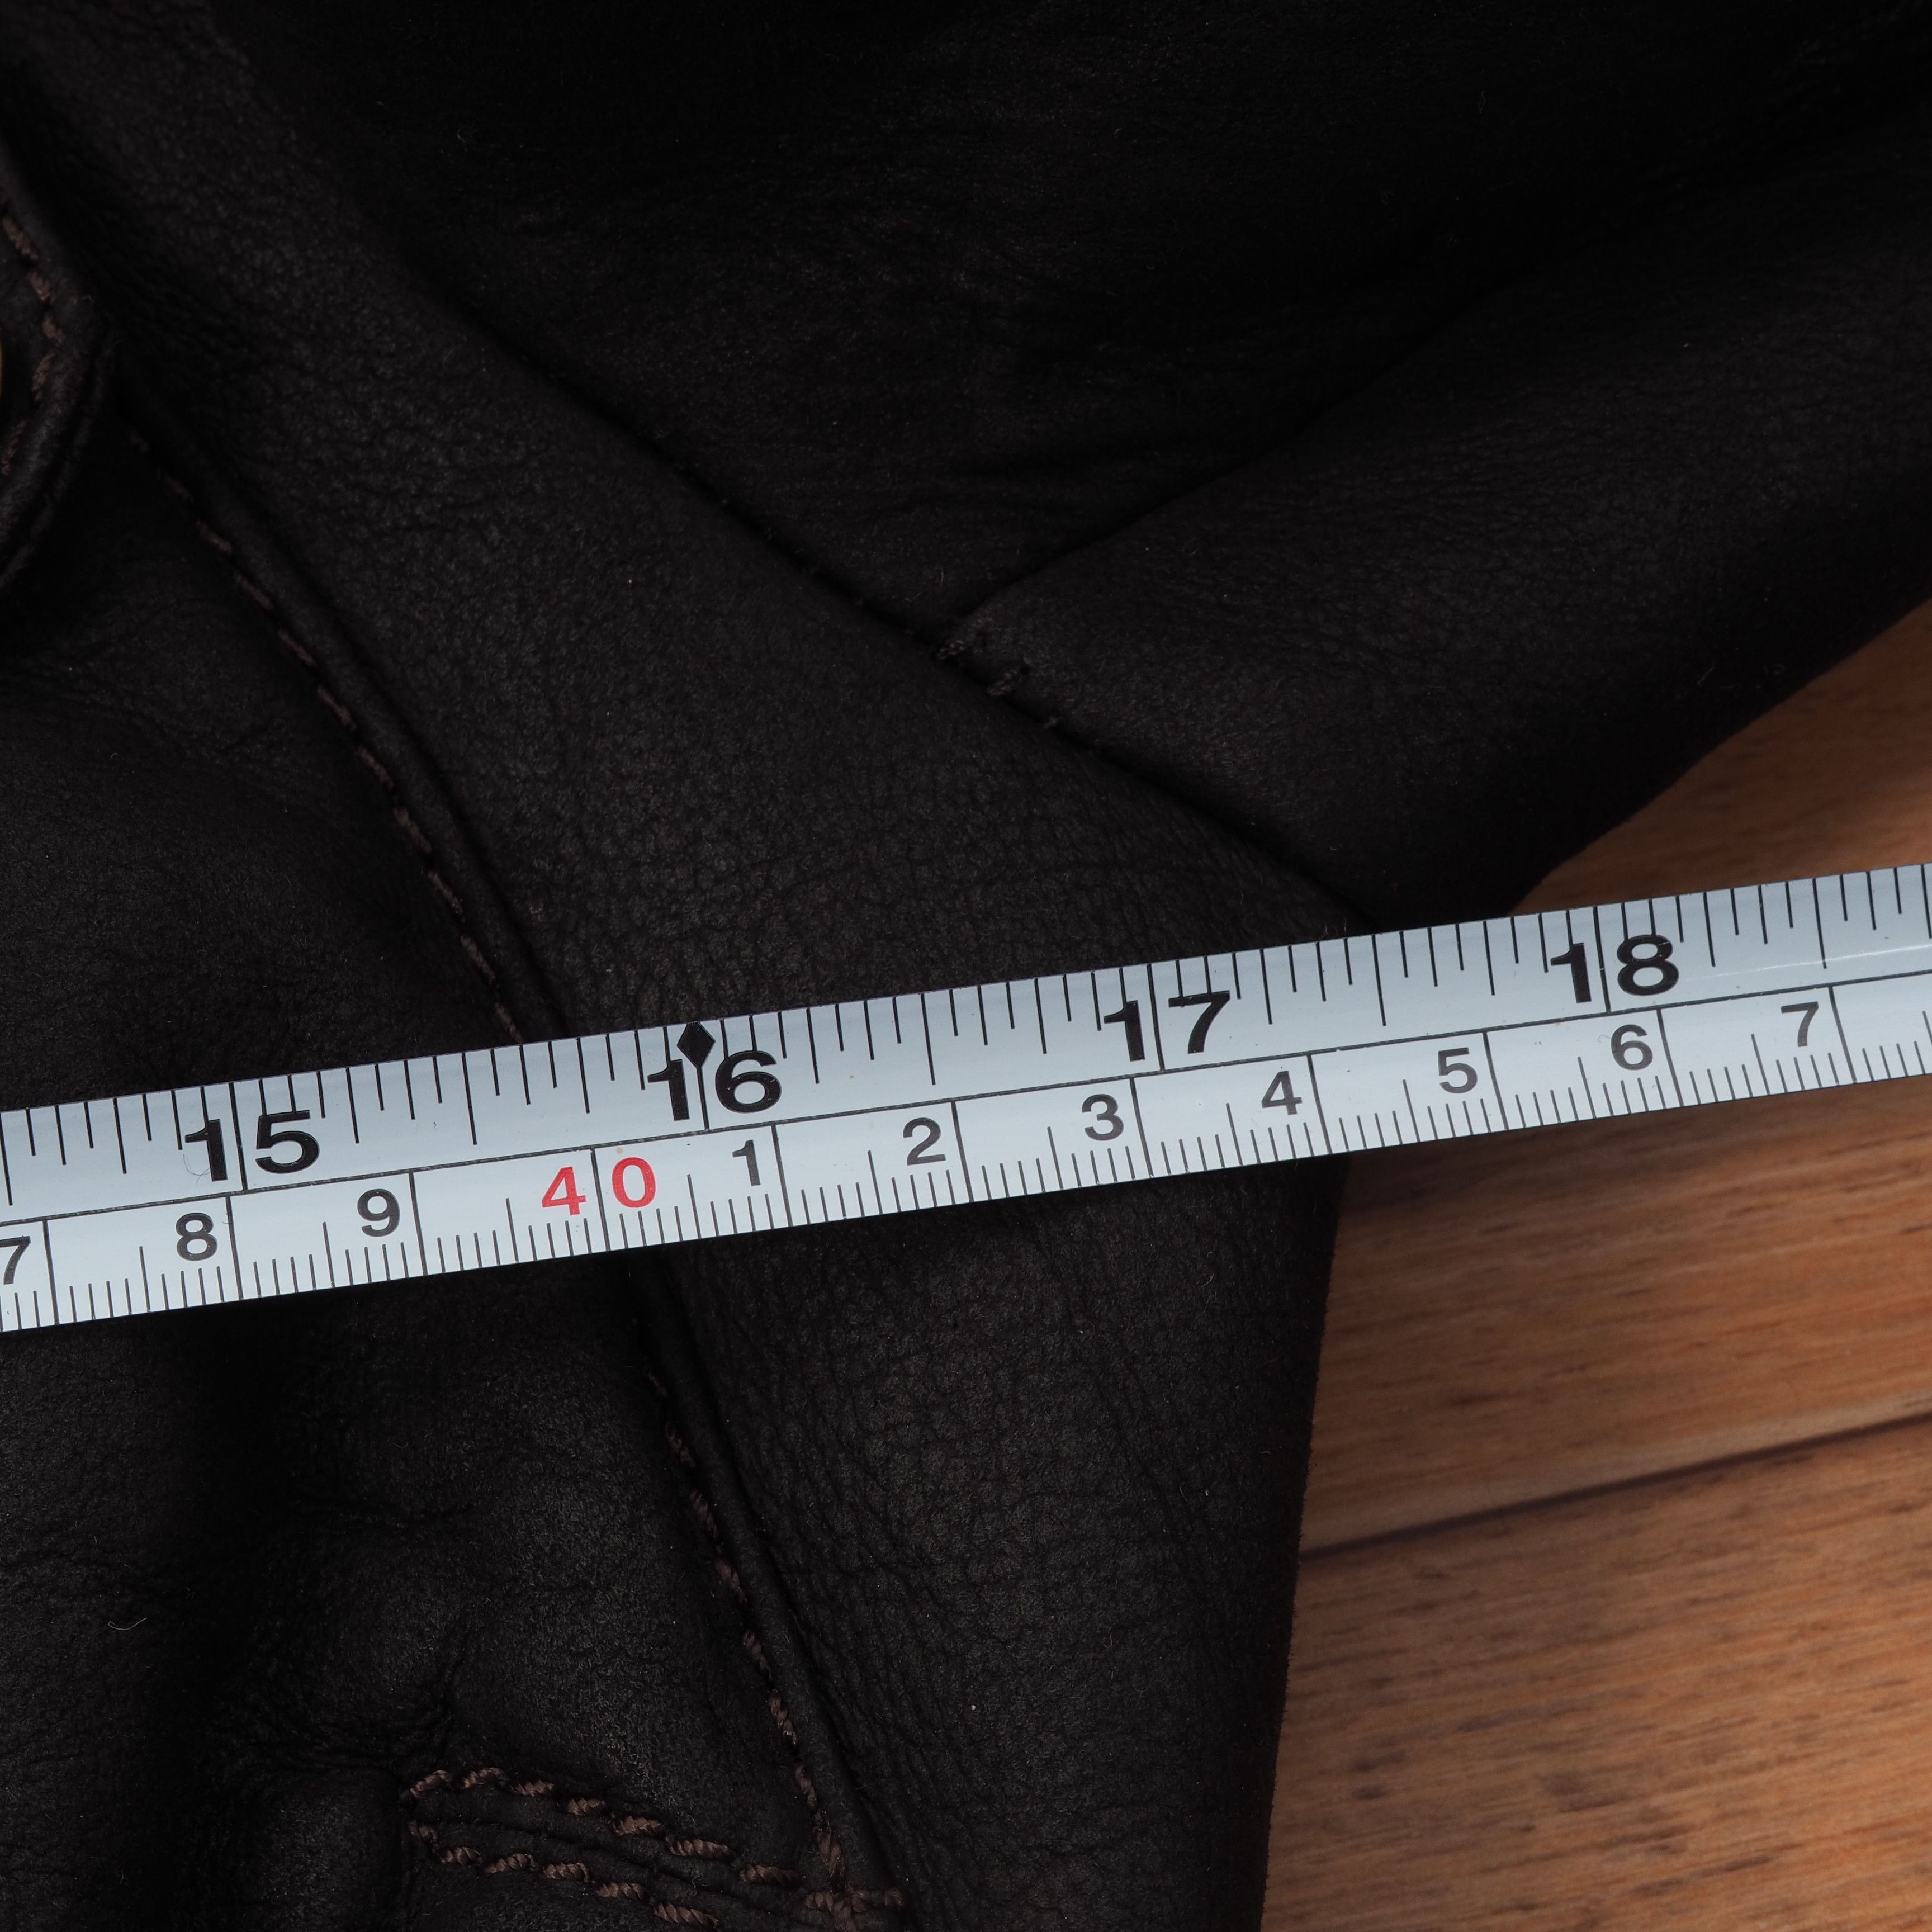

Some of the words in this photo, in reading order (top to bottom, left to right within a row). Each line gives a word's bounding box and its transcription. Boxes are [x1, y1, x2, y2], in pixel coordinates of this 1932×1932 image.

[176, 1213, 217, 1261] 8
[358, 1189, 400, 1237] 9
[542, 1158, 656, 1215] 40
[733, 1140, 761, 1186] 1
[903, 1117, 945, 1165] 2
[1082, 1094, 1123, 1140] 3
[1262, 1071, 1301, 1115] 4
[1438, 1048, 1477, 1093] 5
[1611, 1025, 1652, 1070] 6
[1781, 1001, 1819, 1047] 7
[185, 1110, 320, 1182] 15
[647, 1050, 782, 1121] 16
[1104, 989, 1231, 1060] 17
[1551, 935, 1679, 1003] 18
